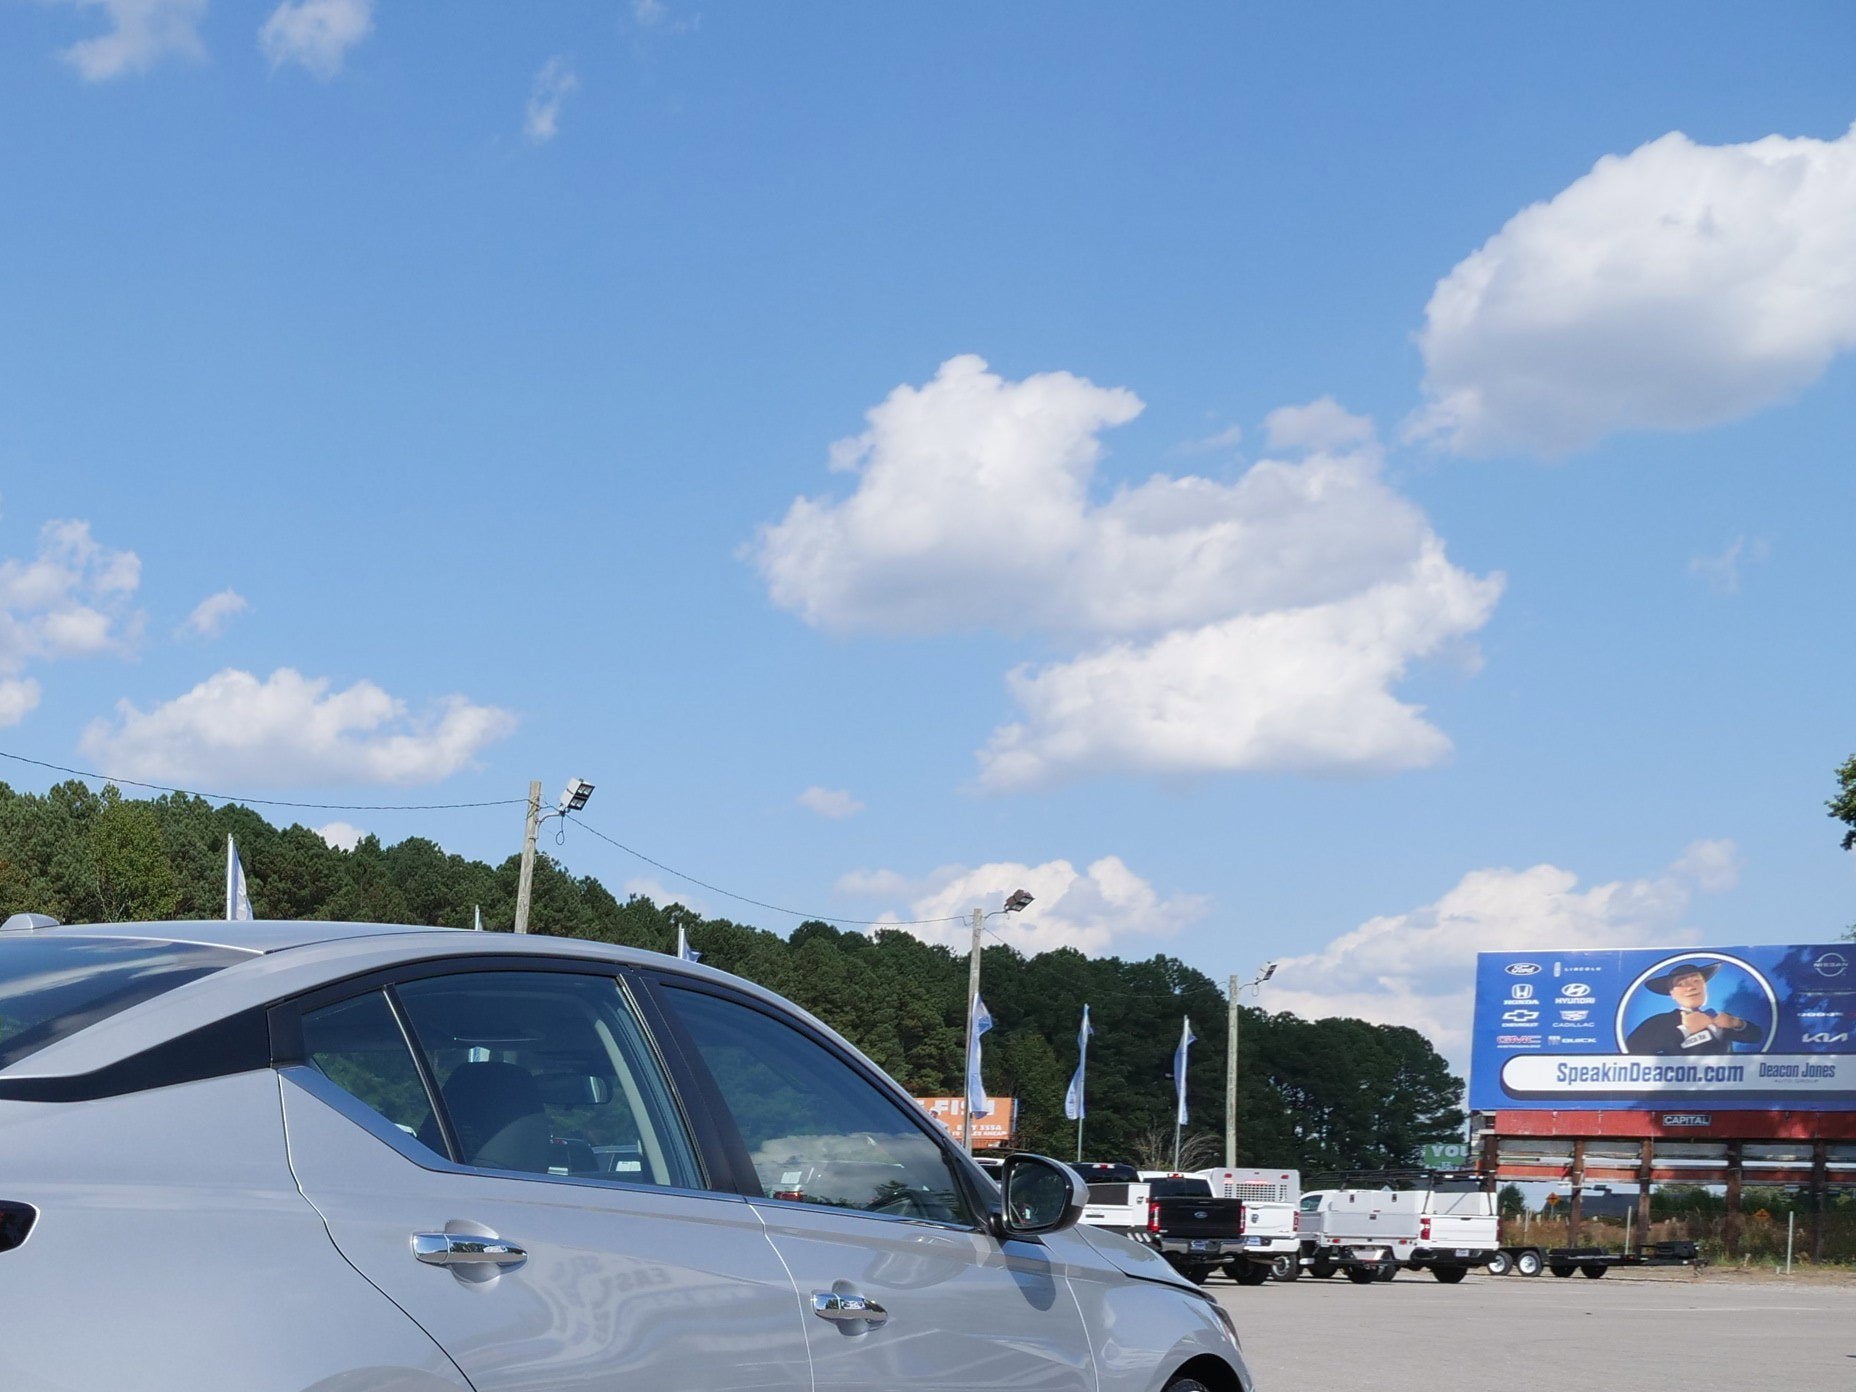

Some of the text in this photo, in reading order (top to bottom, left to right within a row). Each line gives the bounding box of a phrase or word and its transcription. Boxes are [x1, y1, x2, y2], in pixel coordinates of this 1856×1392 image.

[1556, 1062, 1744, 1085] SpeakinDeacon.com
[1758, 1062, 1836, 1078] Deacon Jones
[1664, 1115, 1710, 1125] CAPITAL
